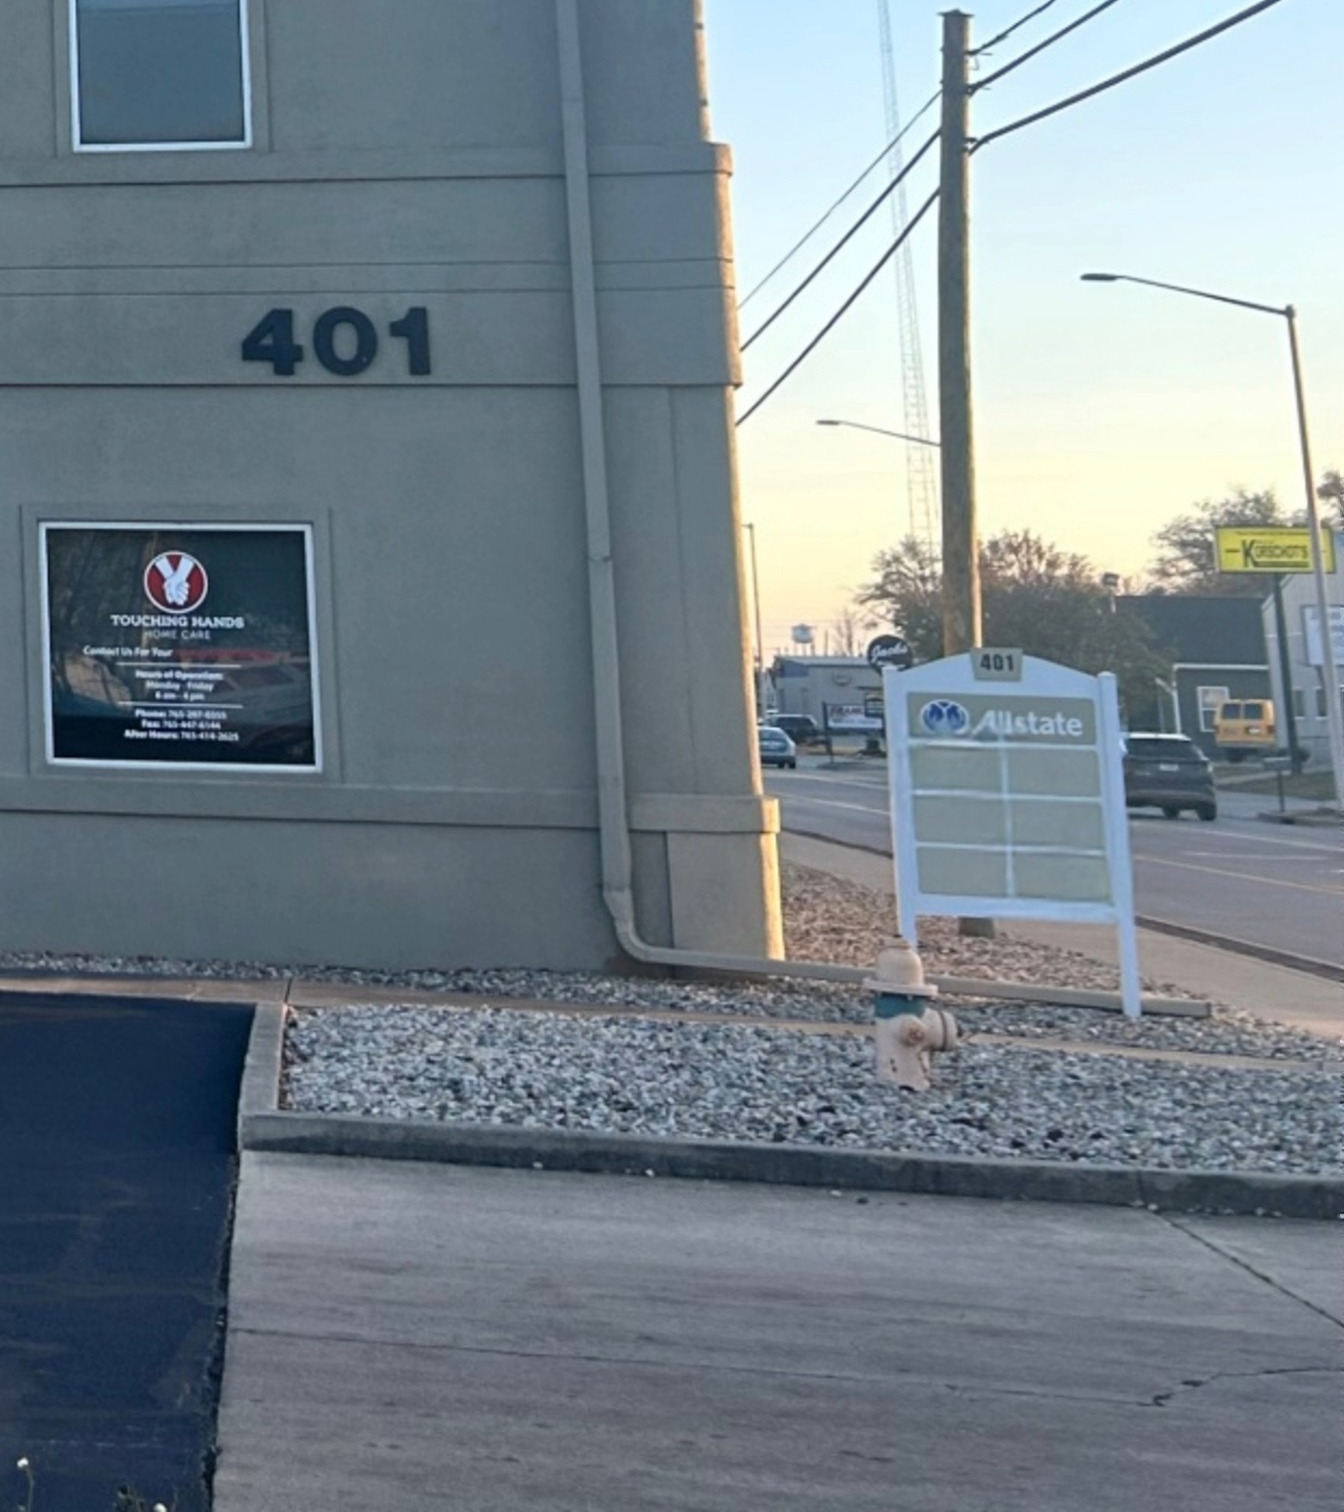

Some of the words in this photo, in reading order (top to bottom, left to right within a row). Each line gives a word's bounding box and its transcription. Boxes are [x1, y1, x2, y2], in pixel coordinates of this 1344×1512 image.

[242, 306, 431, 376] 401
[110, 614, 188, 627] TOUCHING
[192, 616, 245, 629] HANDS
[143, 630, 178, 639] HOME
[180, 630, 211, 640] CARE
[82, 644, 119, 656] Contact
[134, 646, 151, 657] For
[151, 647, 174, 658] Your
[980, 653, 1015, 671] 401
[135, 670, 163, 680] Hours
[971, 709, 1084, 737] Allstate
